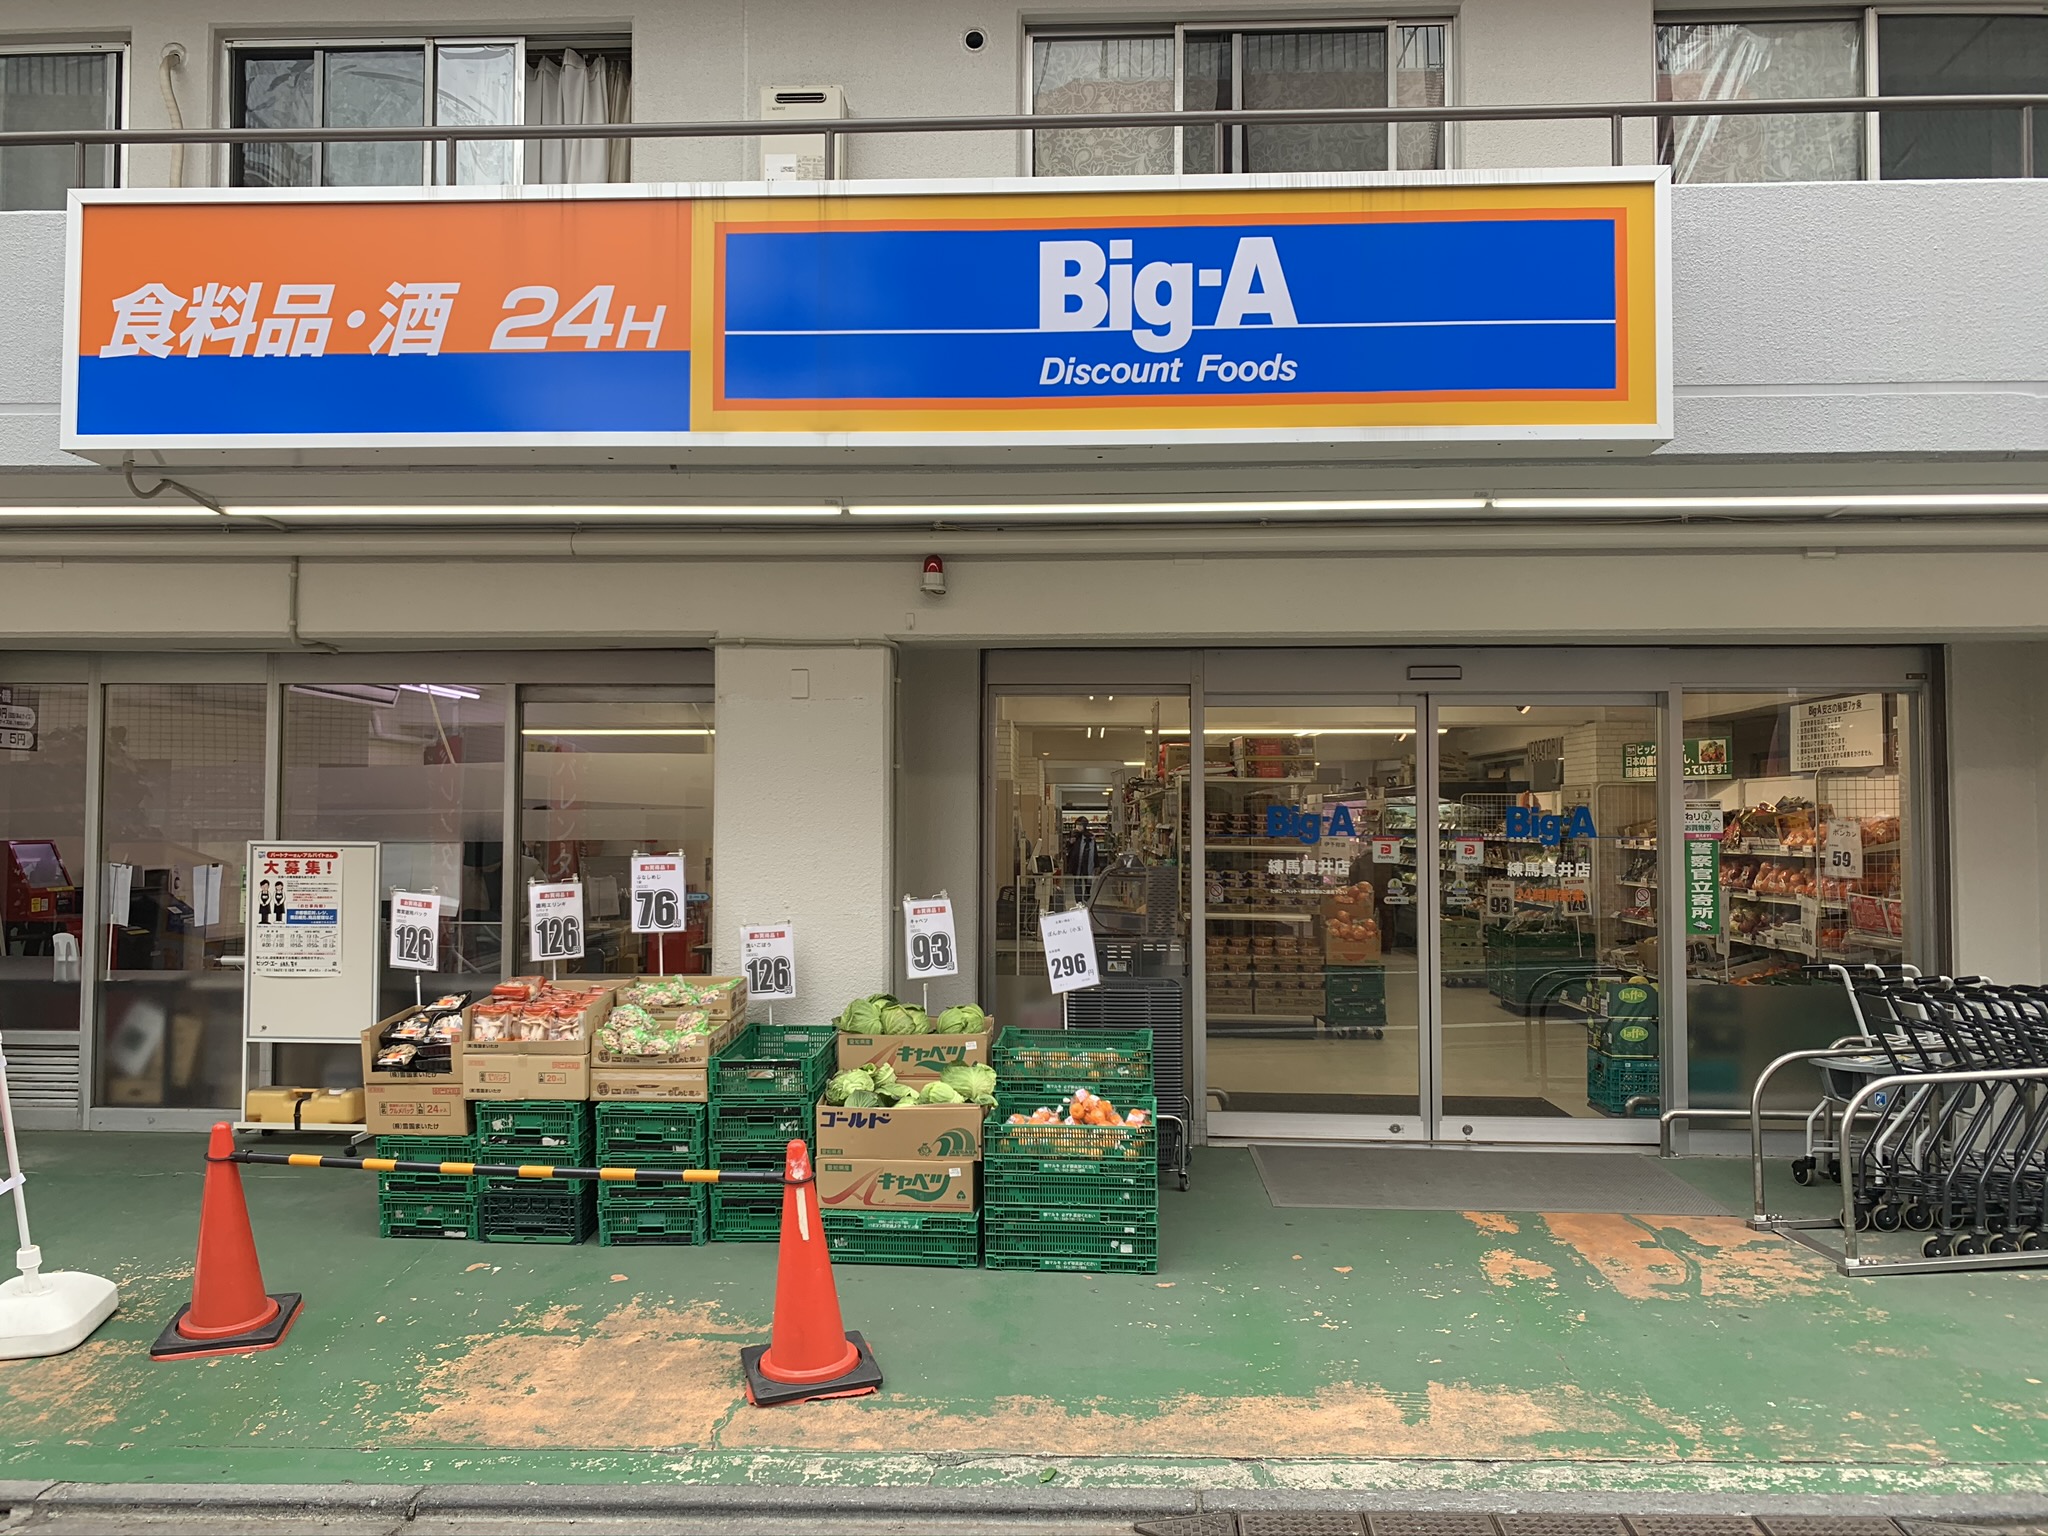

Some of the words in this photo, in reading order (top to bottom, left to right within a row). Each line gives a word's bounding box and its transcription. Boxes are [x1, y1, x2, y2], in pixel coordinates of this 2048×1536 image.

[1039, 237, 1299, 353] Big-A
[99, 281, 460, 359] 食料品・酒
[489, 284, 666, 350] 24H
[1039, 357, 1183, 385] Discount
[1197, 353, 1298, 382] Foods
[264, 860, 332, 874] 大募集!
[1690, 842, 1714, 919] 警察官立寄所
[896, 1045, 967, 1062] キャベツ
[820, 1111, 892, 1129] ゴールド
[877, 1173, 951, 1193] キャベツ
